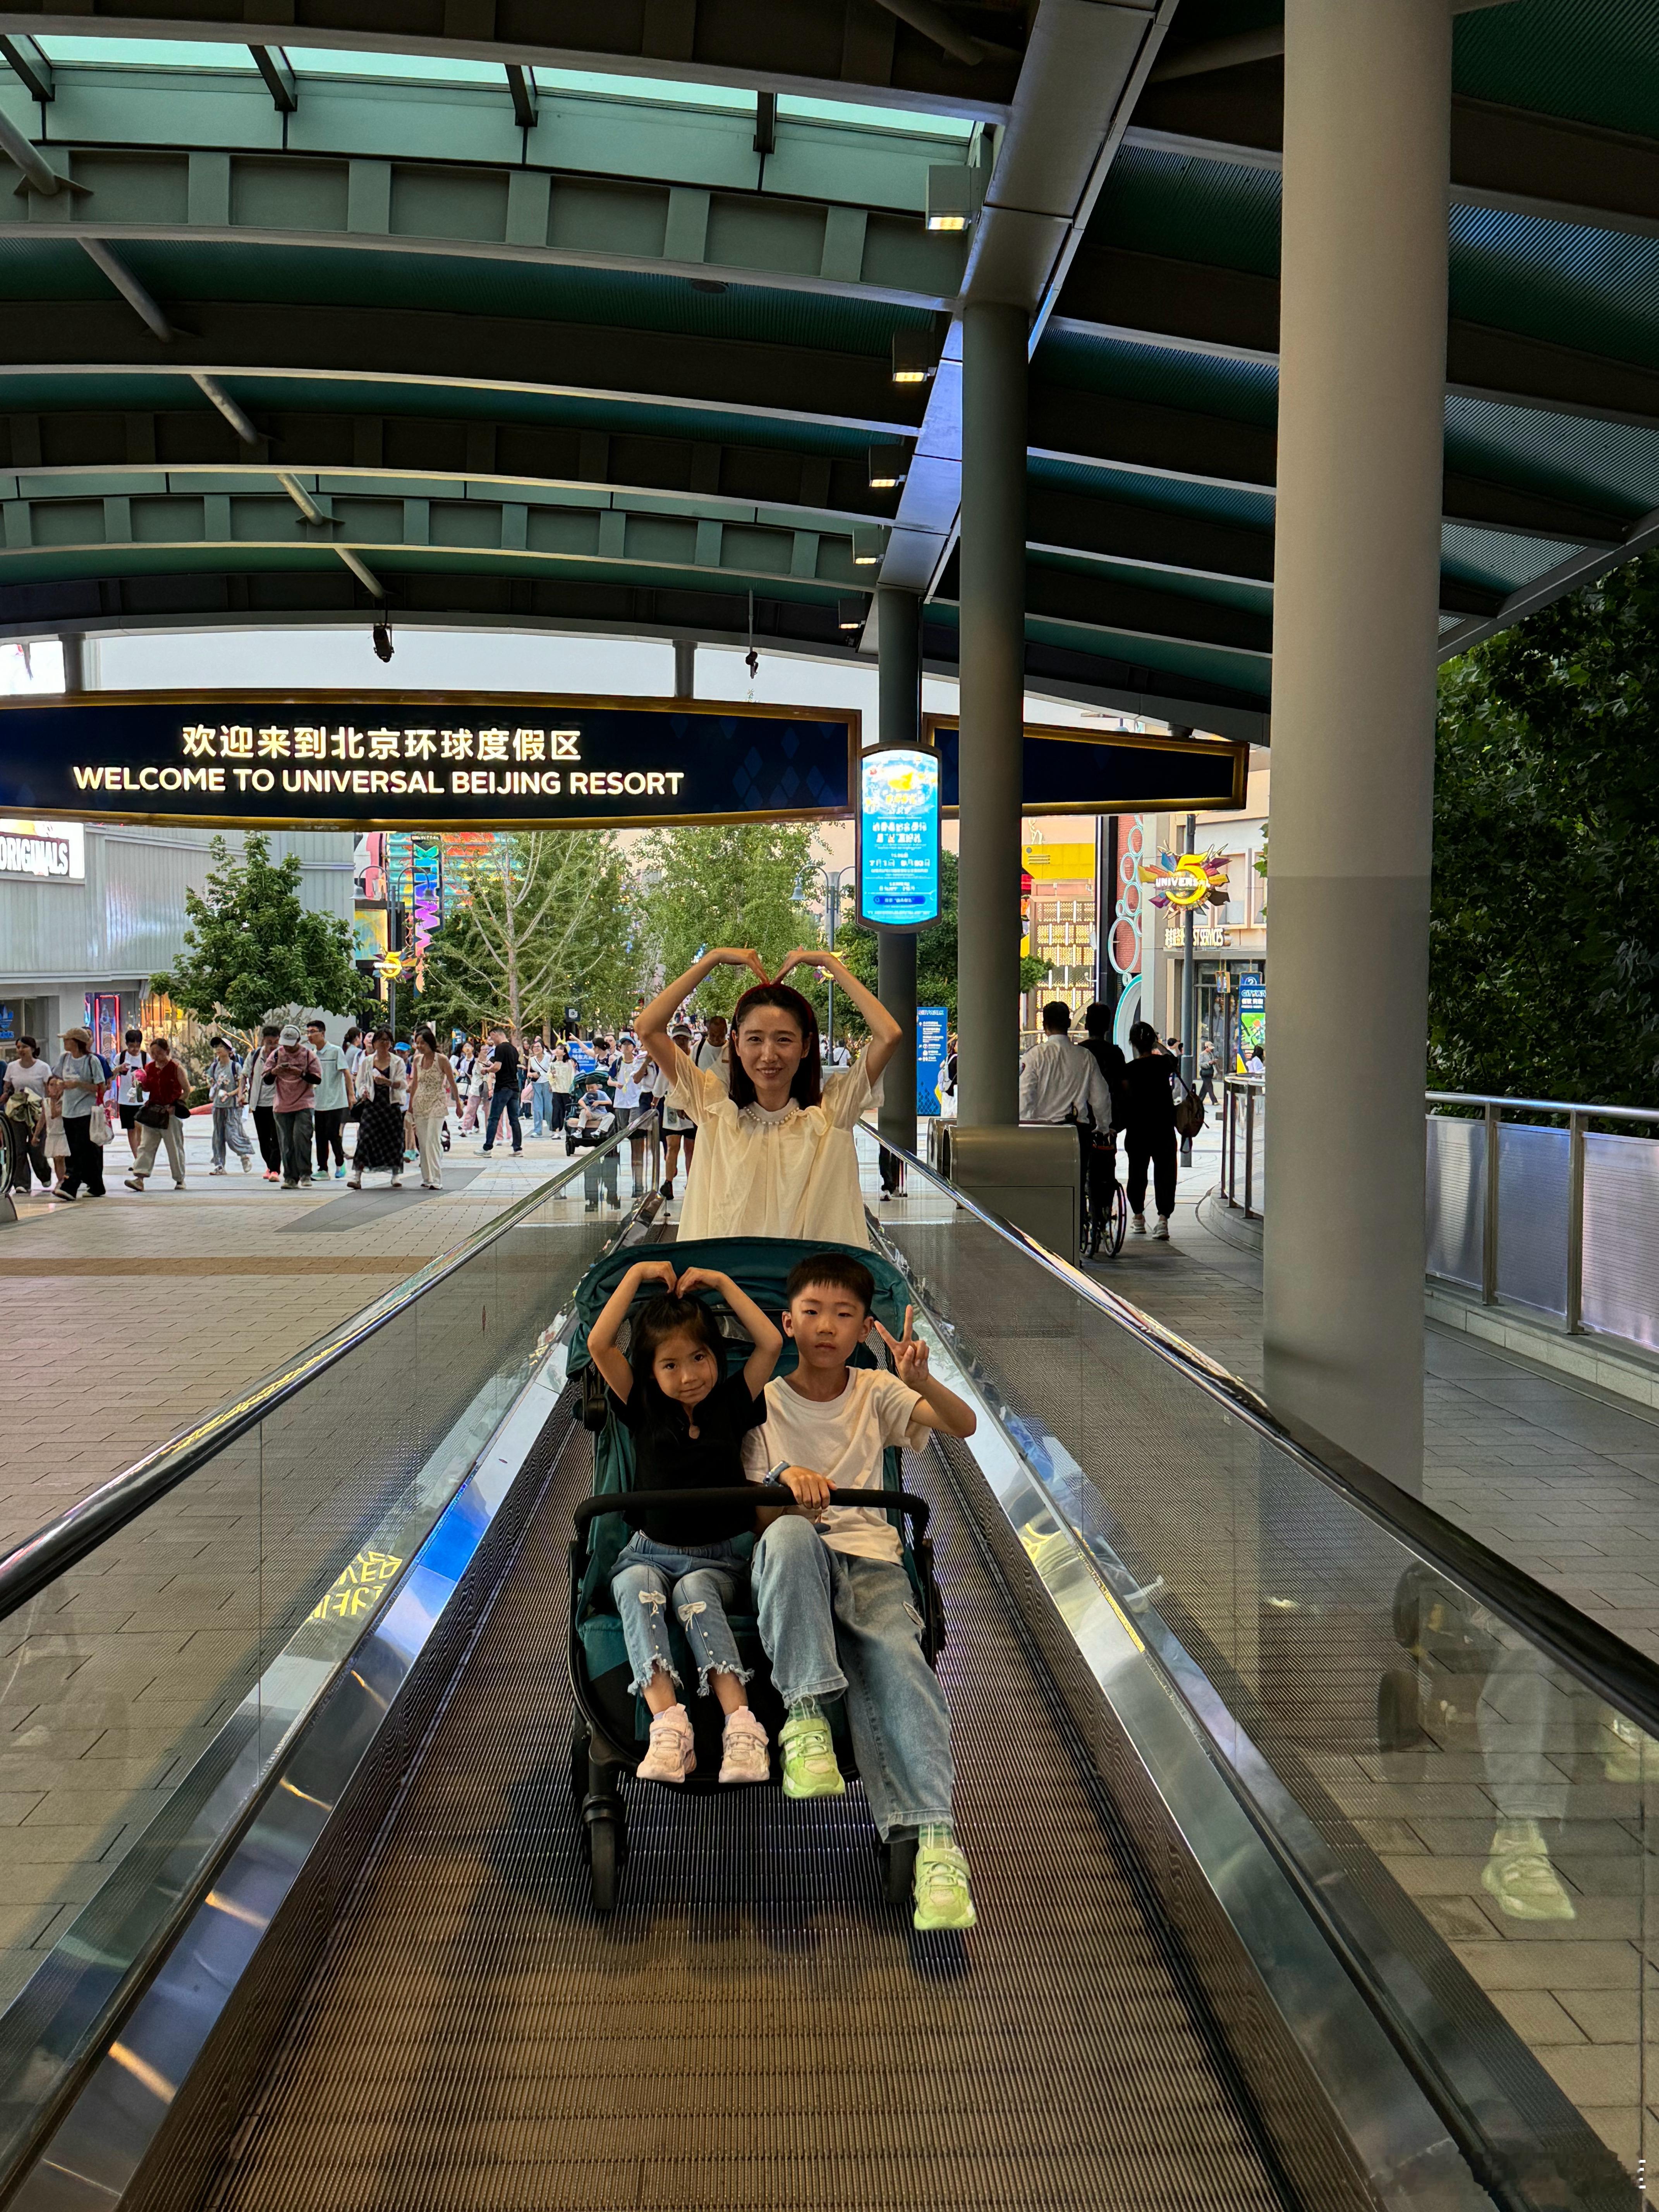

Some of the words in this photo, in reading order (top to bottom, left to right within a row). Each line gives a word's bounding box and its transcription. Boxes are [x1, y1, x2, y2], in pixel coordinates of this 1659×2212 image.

[182, 724, 581, 761] 欢迎来到北京环球度假区
[73, 766, 226, 791] WELCOME
[233, 769, 275, 791] TO
[283, 769, 445, 793] UNIVERSAL
[452, 771, 561, 794] BEIJING
[570, 772, 684, 795] RESORT
